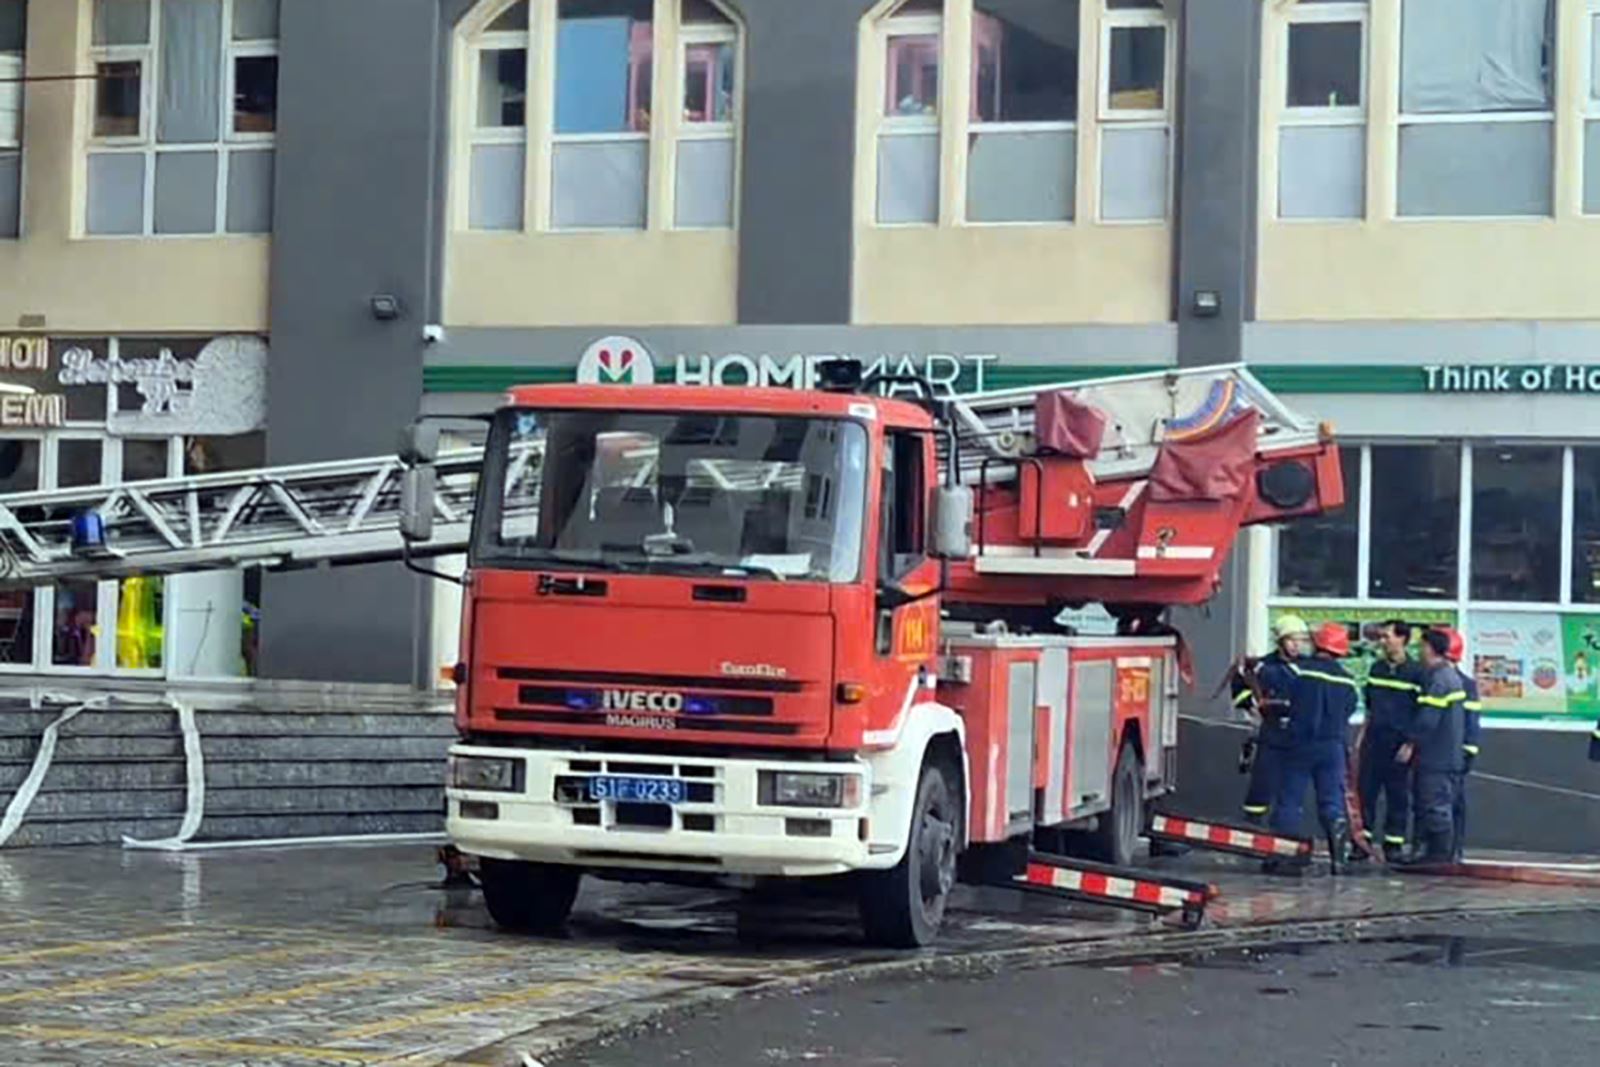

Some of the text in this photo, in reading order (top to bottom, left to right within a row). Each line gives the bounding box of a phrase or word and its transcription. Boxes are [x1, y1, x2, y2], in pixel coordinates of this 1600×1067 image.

[1422, 365, 1510, 391] Think
[1520, 365, 1553, 391] of
[602, 689, 683, 713] IVECO
[606, 714, 677, 731] MAGIRUS
